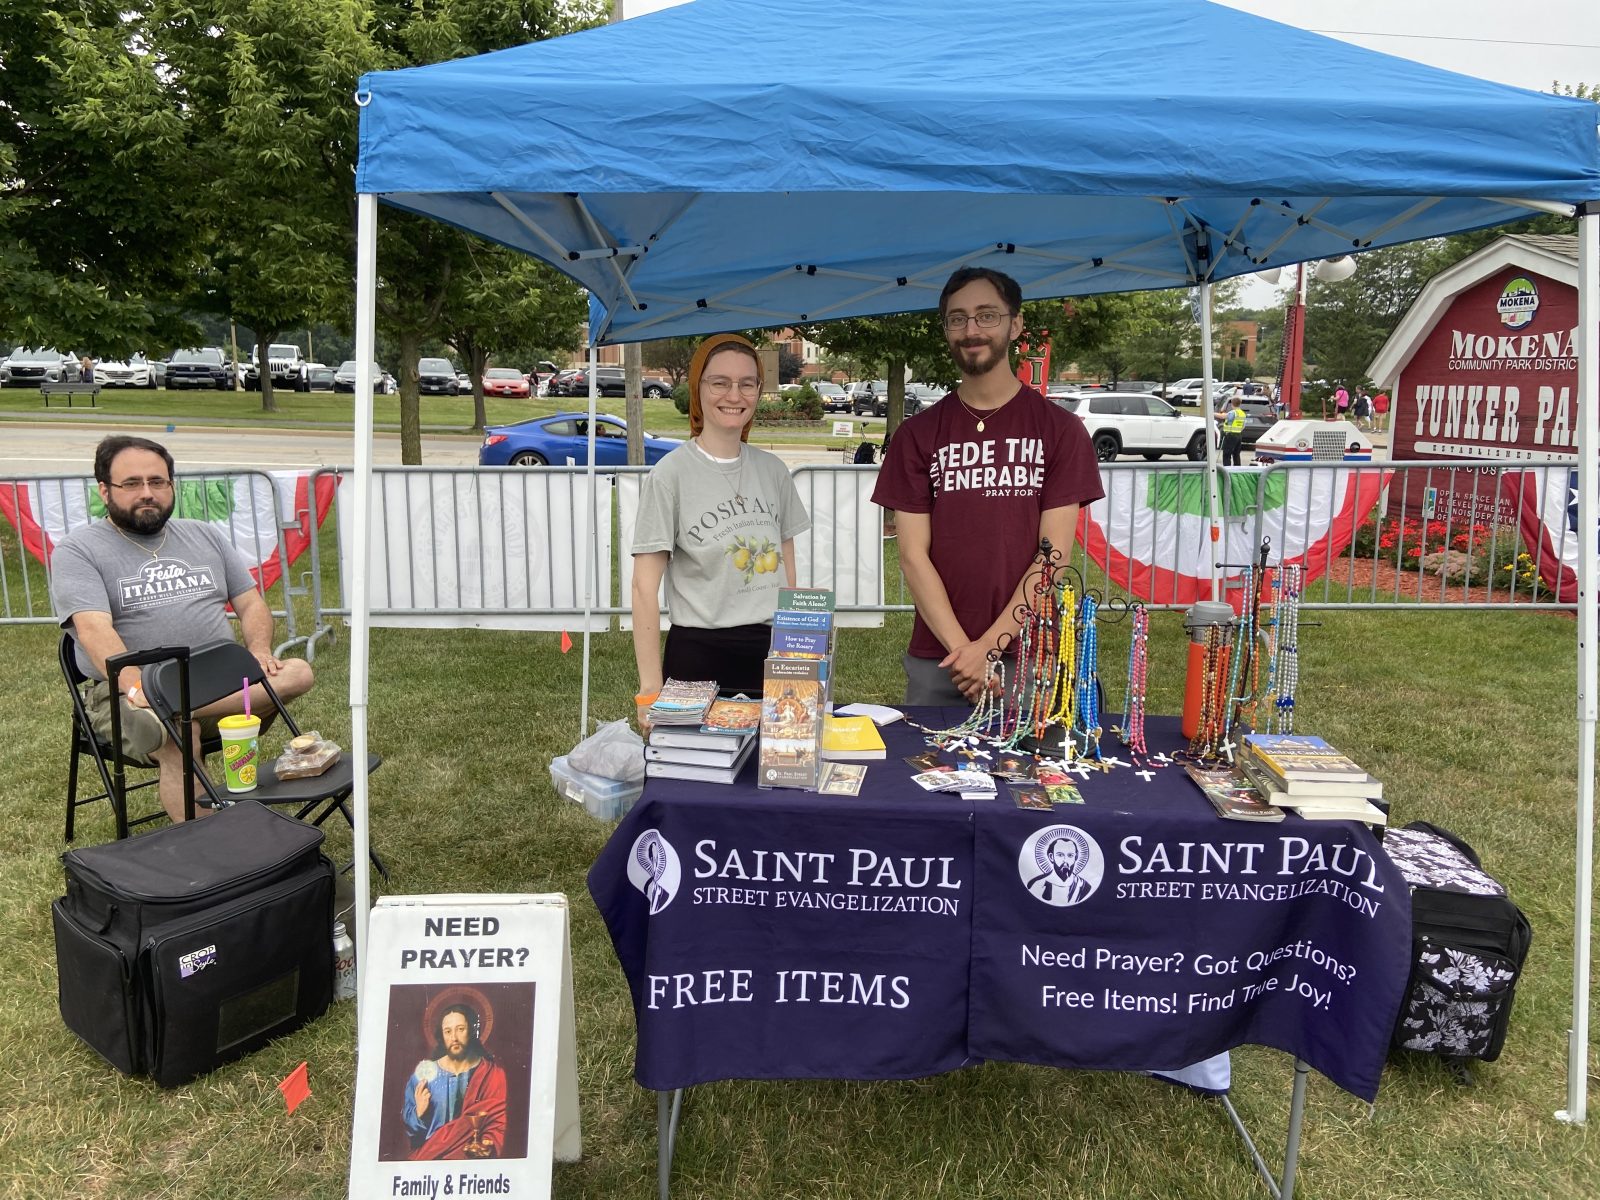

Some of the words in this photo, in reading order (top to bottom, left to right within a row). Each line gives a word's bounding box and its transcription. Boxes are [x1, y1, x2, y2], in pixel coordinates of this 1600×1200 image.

[1500, 297, 1535, 307] MOKENA
[1449, 359, 1504, 370] COMMUNITY
[1506, 359, 1531, 370] PARK
[1535, 358, 1579, 370] DISTRIC
[1415, 385, 1520, 443] YUNKER
[1534, 386, 1579, 447] PA
[1005, 437, 1045, 465] THE
[943, 465, 1045, 492] ENERABLE
[1440, 489, 1460, 499] OPN
[1437, 506, 1471, 517] ILLNOIS
[144, 564, 187, 582] Festa
[123, 574, 212, 599] ITALIANA
[820, 593, 826, 601] by
[805, 636, 816, 644] Pray
[693, 839, 835, 884] SAINT
[847, 849, 962, 889] PAUL
[1118, 836, 1264, 874] SAINT
[1277, 837, 1385, 893] PAUL
[693, 887, 769, 907] STREET
[775, 891, 960, 917] EVANGELIZATION
[1116, 881, 1195, 899] STREET
[1201, 878, 1382, 919] EVANGELIZATION
[424, 917, 500, 937] NEED
[181, 946, 214, 964] CROP
[401, 947, 530, 969] PRAYER?
[1021, 944, 1086, 968] Need
[1095, 948, 1185, 976] Prayer?
[1193, 954, 1238, 976] Got
[1246, 940, 1358, 986] Questions?
[647, 969, 753, 1009] FREE
[775, 970, 909, 1009] ITEMS
[1042, 985, 1094, 1009] Free
[1103, 988, 1178, 1014] Items!
[1188, 989, 1234, 1014] Find
[1242, 975, 1278, 1003] True
[1285, 974, 1332, 1011] Joy!
[393, 1174, 439, 1200] Family
[443, 1174, 454, 1196] &
[459, 1173, 510, 1195] Friends
